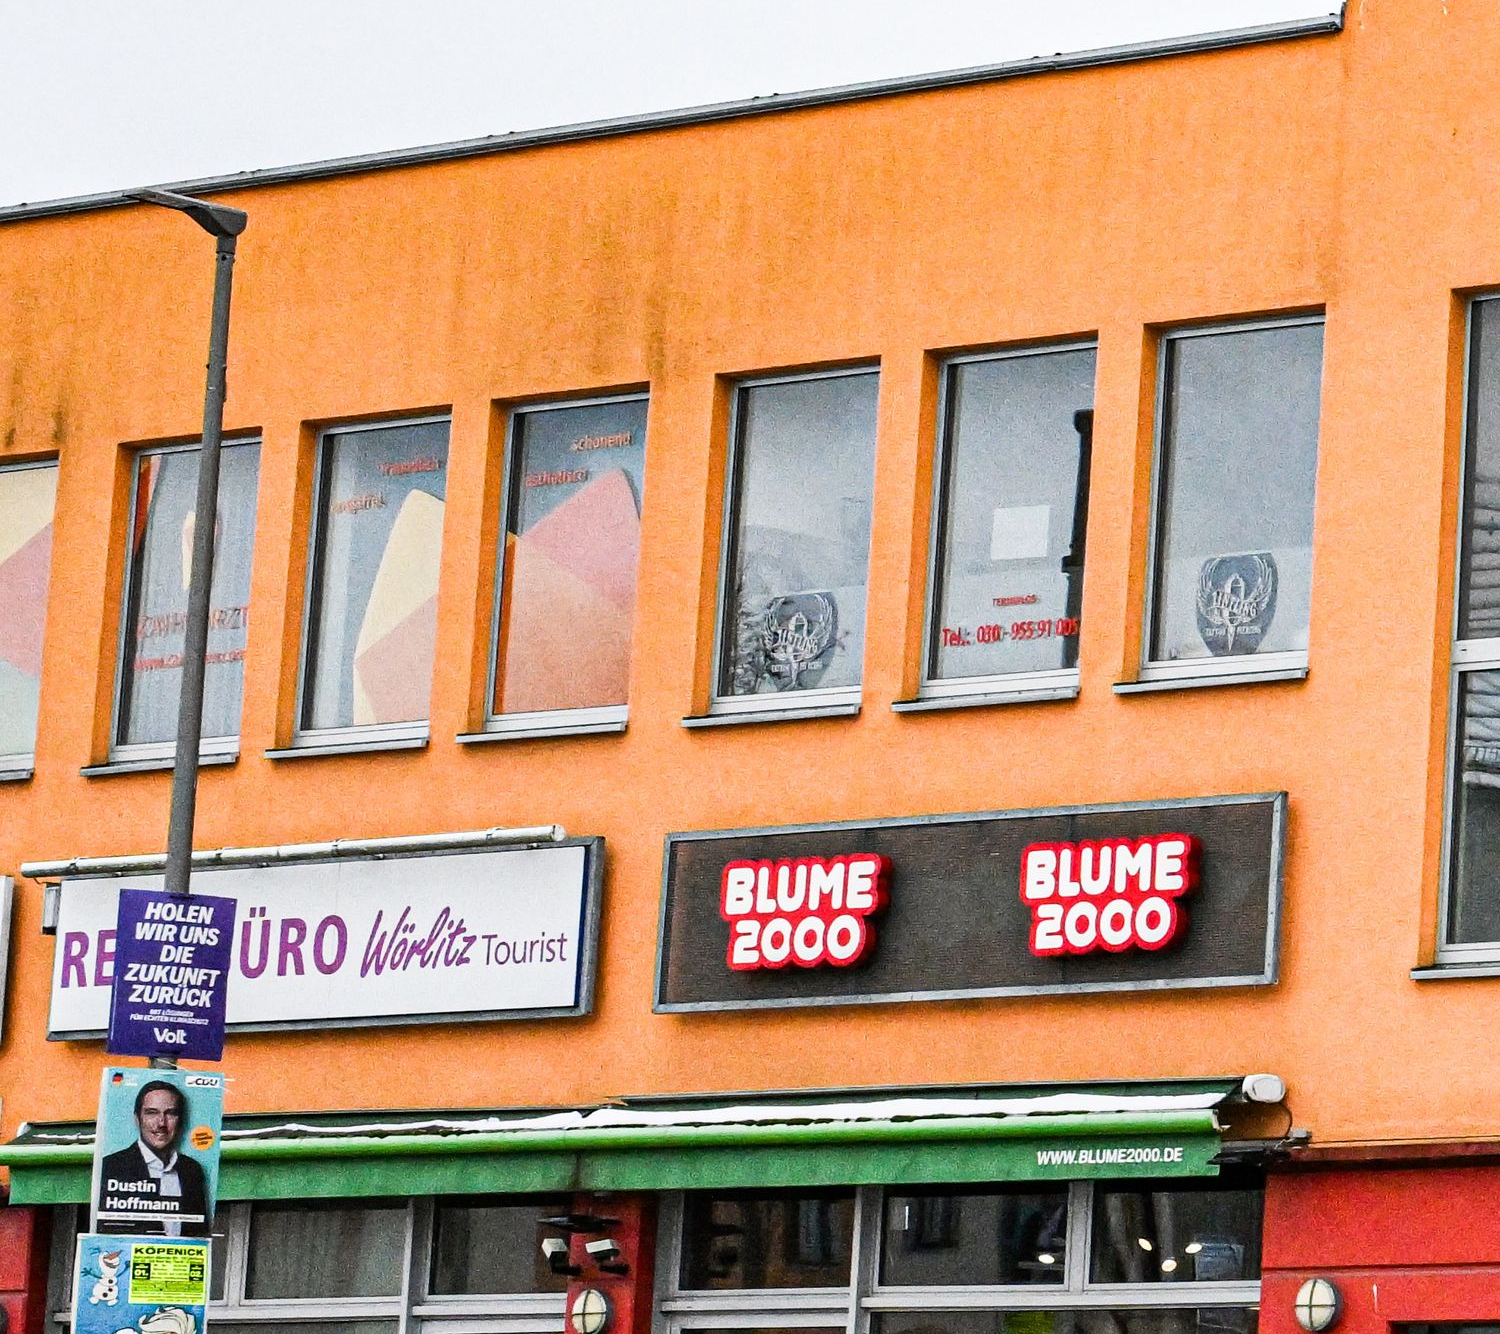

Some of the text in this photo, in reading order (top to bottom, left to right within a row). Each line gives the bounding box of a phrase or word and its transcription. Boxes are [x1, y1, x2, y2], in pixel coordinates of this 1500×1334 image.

[1025, 838, 1187, 898] BLUME
[725, 860, 880, 915] BLUME
[144, 901, 215, 925] HOLEN
[1032, 897, 1173, 950] 2000
[135, 922, 221, 946] WIR UNS
[361, 906, 479, 979] Wörlitz
[481, 930, 569, 967] Tourist
[732, 913, 867, 964] 2000
[159, 945, 195, 964] DIE
[123, 963, 221, 988] ZUKUNFT
[128, 983, 215, 1008] ZURÜCK
[153, 1027, 188, 1045] Volt
[195, 1077, 219, 1087] CDU
[1037, 1147, 1184, 1166] WWW.BLUME2000.DE
[107, 1179, 157, 1193] Dustin
[105, 1197, 180, 1211] Hoffmann
[134, 1246, 204, 1256] KÖPENICK
